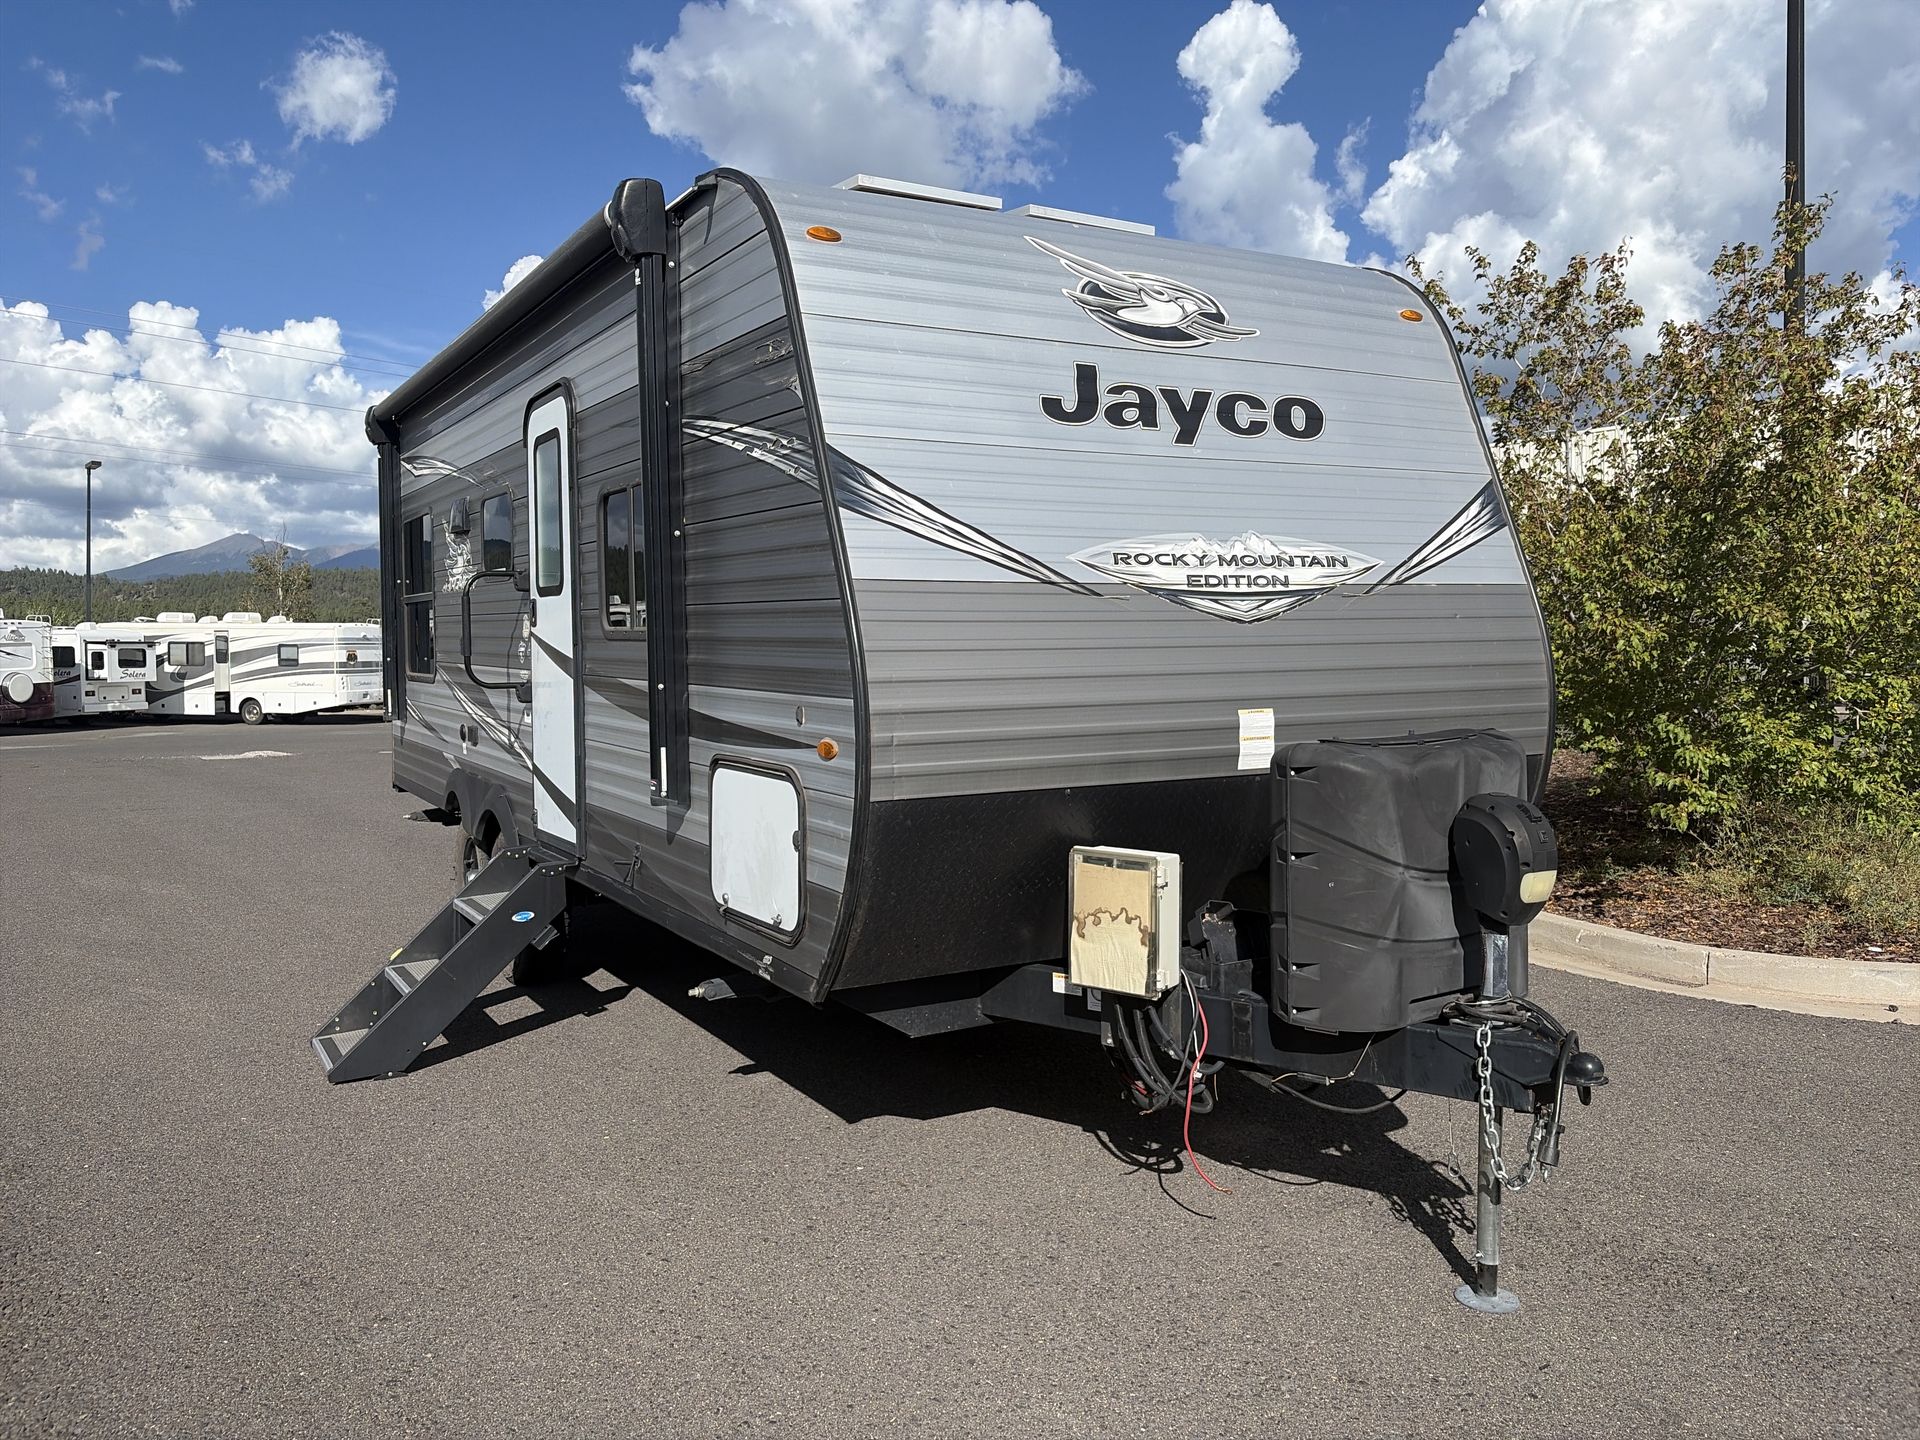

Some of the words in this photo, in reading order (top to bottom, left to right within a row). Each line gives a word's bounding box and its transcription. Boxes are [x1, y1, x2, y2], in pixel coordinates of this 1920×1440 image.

[1040, 361, 1325, 447] Jayco
[1113, 552, 1208, 566] ROCKY
[1218, 553, 1349, 568] MOUNTAIN
[1186, 574, 1290, 588] EDITION
[120, 669, 146, 679] Solera
